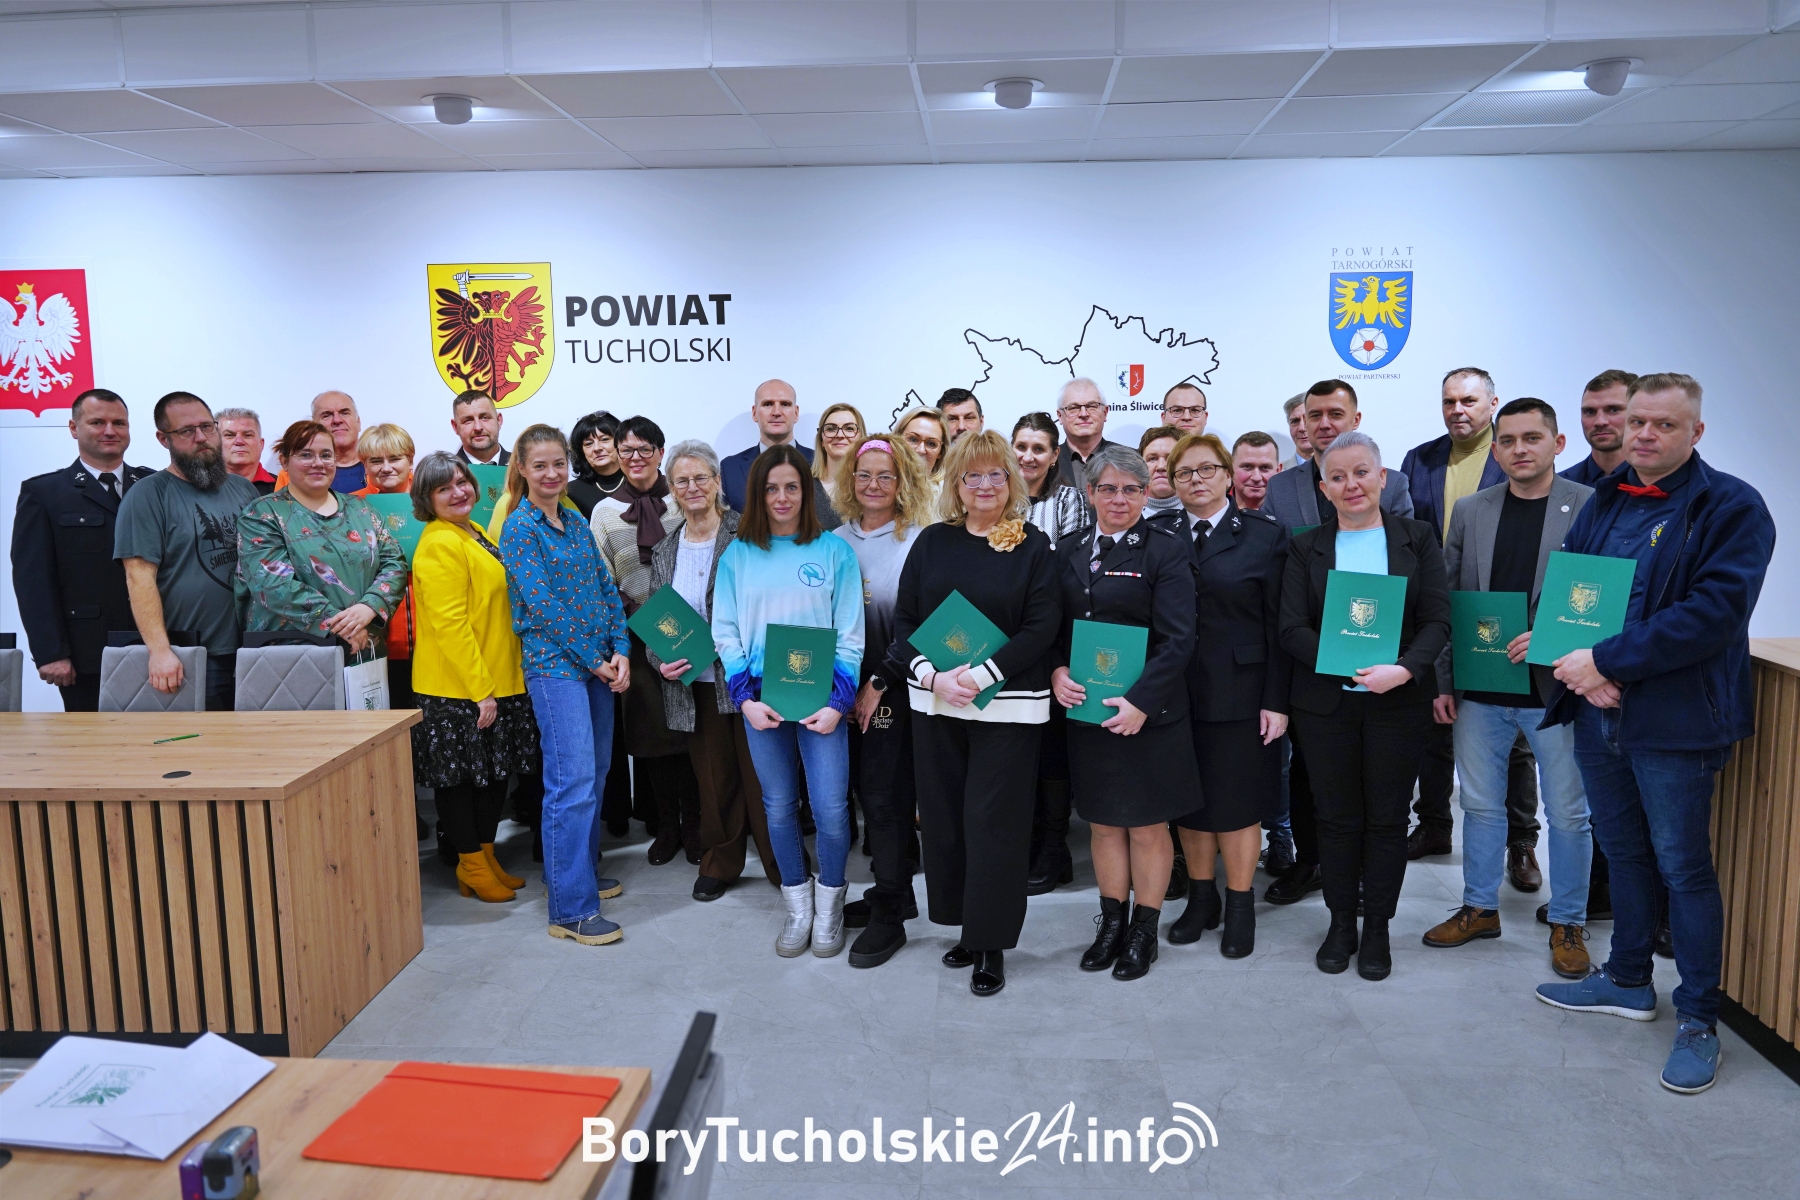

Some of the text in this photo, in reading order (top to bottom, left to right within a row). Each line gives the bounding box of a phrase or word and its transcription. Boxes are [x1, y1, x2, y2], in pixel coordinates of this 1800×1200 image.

[1332, 247, 1414, 256] POWIAT
[1331, 258, 1413, 270] TARNOGÓRSKI
[566, 294, 731, 327] POWIAT
[565, 337, 731, 364] TUCHOLSKI
[1130, 400, 1164, 411] Śliwice
